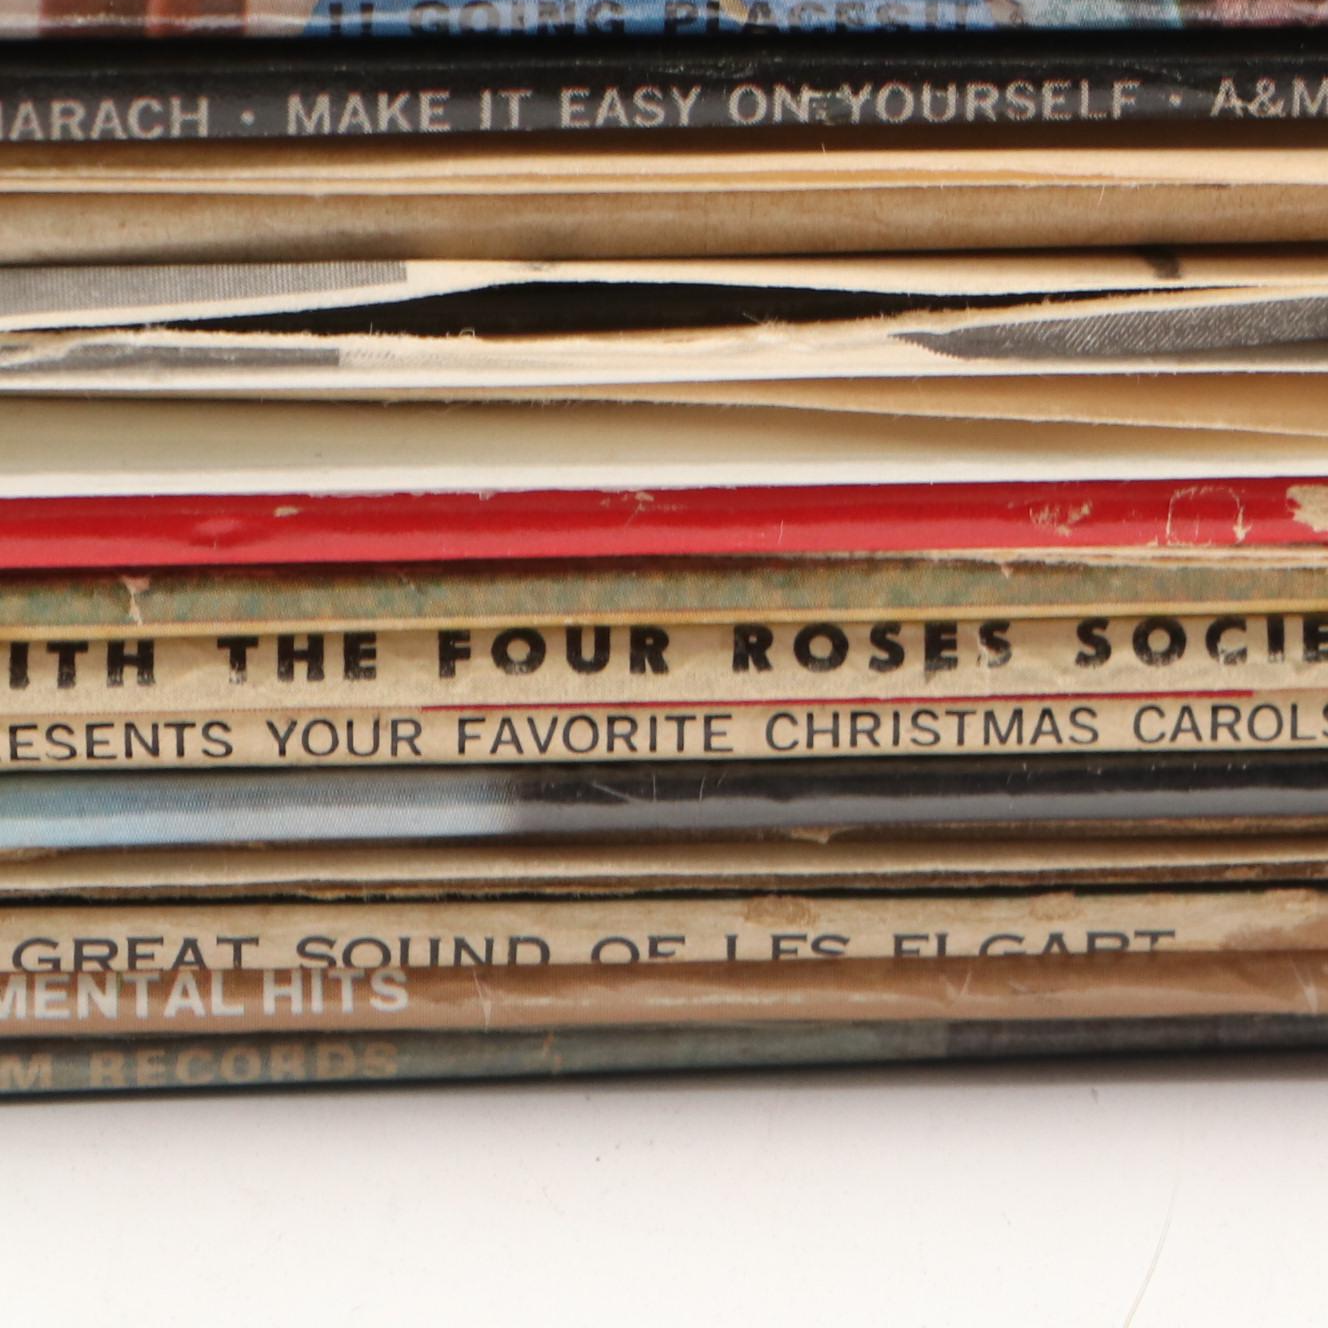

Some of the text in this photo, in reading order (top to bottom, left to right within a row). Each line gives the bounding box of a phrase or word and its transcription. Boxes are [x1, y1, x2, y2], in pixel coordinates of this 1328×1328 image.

[0, 96, 209, 141] ARACH
[287, 89, 452, 135] MAKE
[480, 88, 532, 130] IT
[561, 84, 697, 129] EASY
[728, 82, 812, 124] ON
[841, 79, 1138, 123] YOURSELF
[8, 639, 156, 690] ITH
[217, 633, 379, 684] THE
[438, 623, 670, 679] FOUR
[731, 617, 1013, 674] ROSES
[0, 720, 234, 762] ESENTS
[265, 717, 424, 759] YOUR
[457, 713, 735, 757] FAVORITE
[764, 705, 1101, 752] CHRISTMAS
[12, 936, 260, 972] GREAT
[296, 934, 552, 969] SOUND
[0, 968, 410, 1020] MENTAL HITS
[89, 1042, 399, 1087] RECORDS
